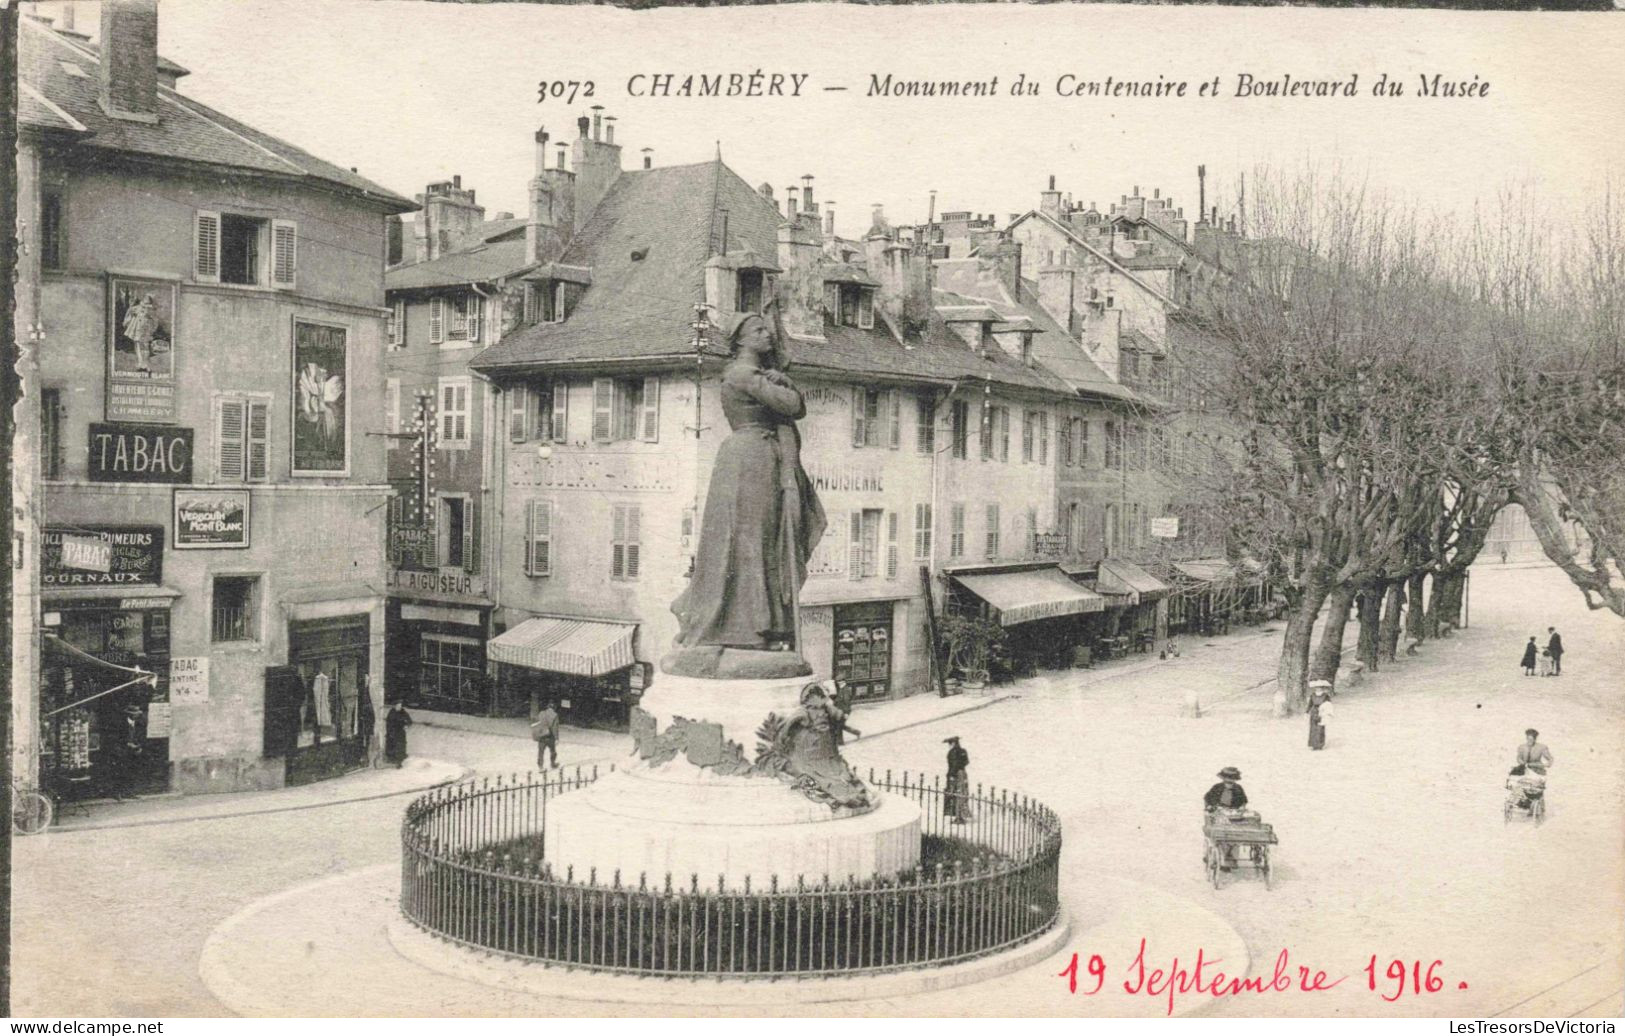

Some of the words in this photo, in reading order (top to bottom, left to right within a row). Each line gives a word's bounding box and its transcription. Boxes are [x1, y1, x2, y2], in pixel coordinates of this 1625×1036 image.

[96, 434, 186, 475] TABAC
[62, 541, 110, 567] TABAC
[44, 573, 142, 583] OURNAUX
[409, 573, 472, 594] AIGUISEUR
[1058, 952, 1107, 997] 19
[1123, 937, 1346, 1017] Septembre
